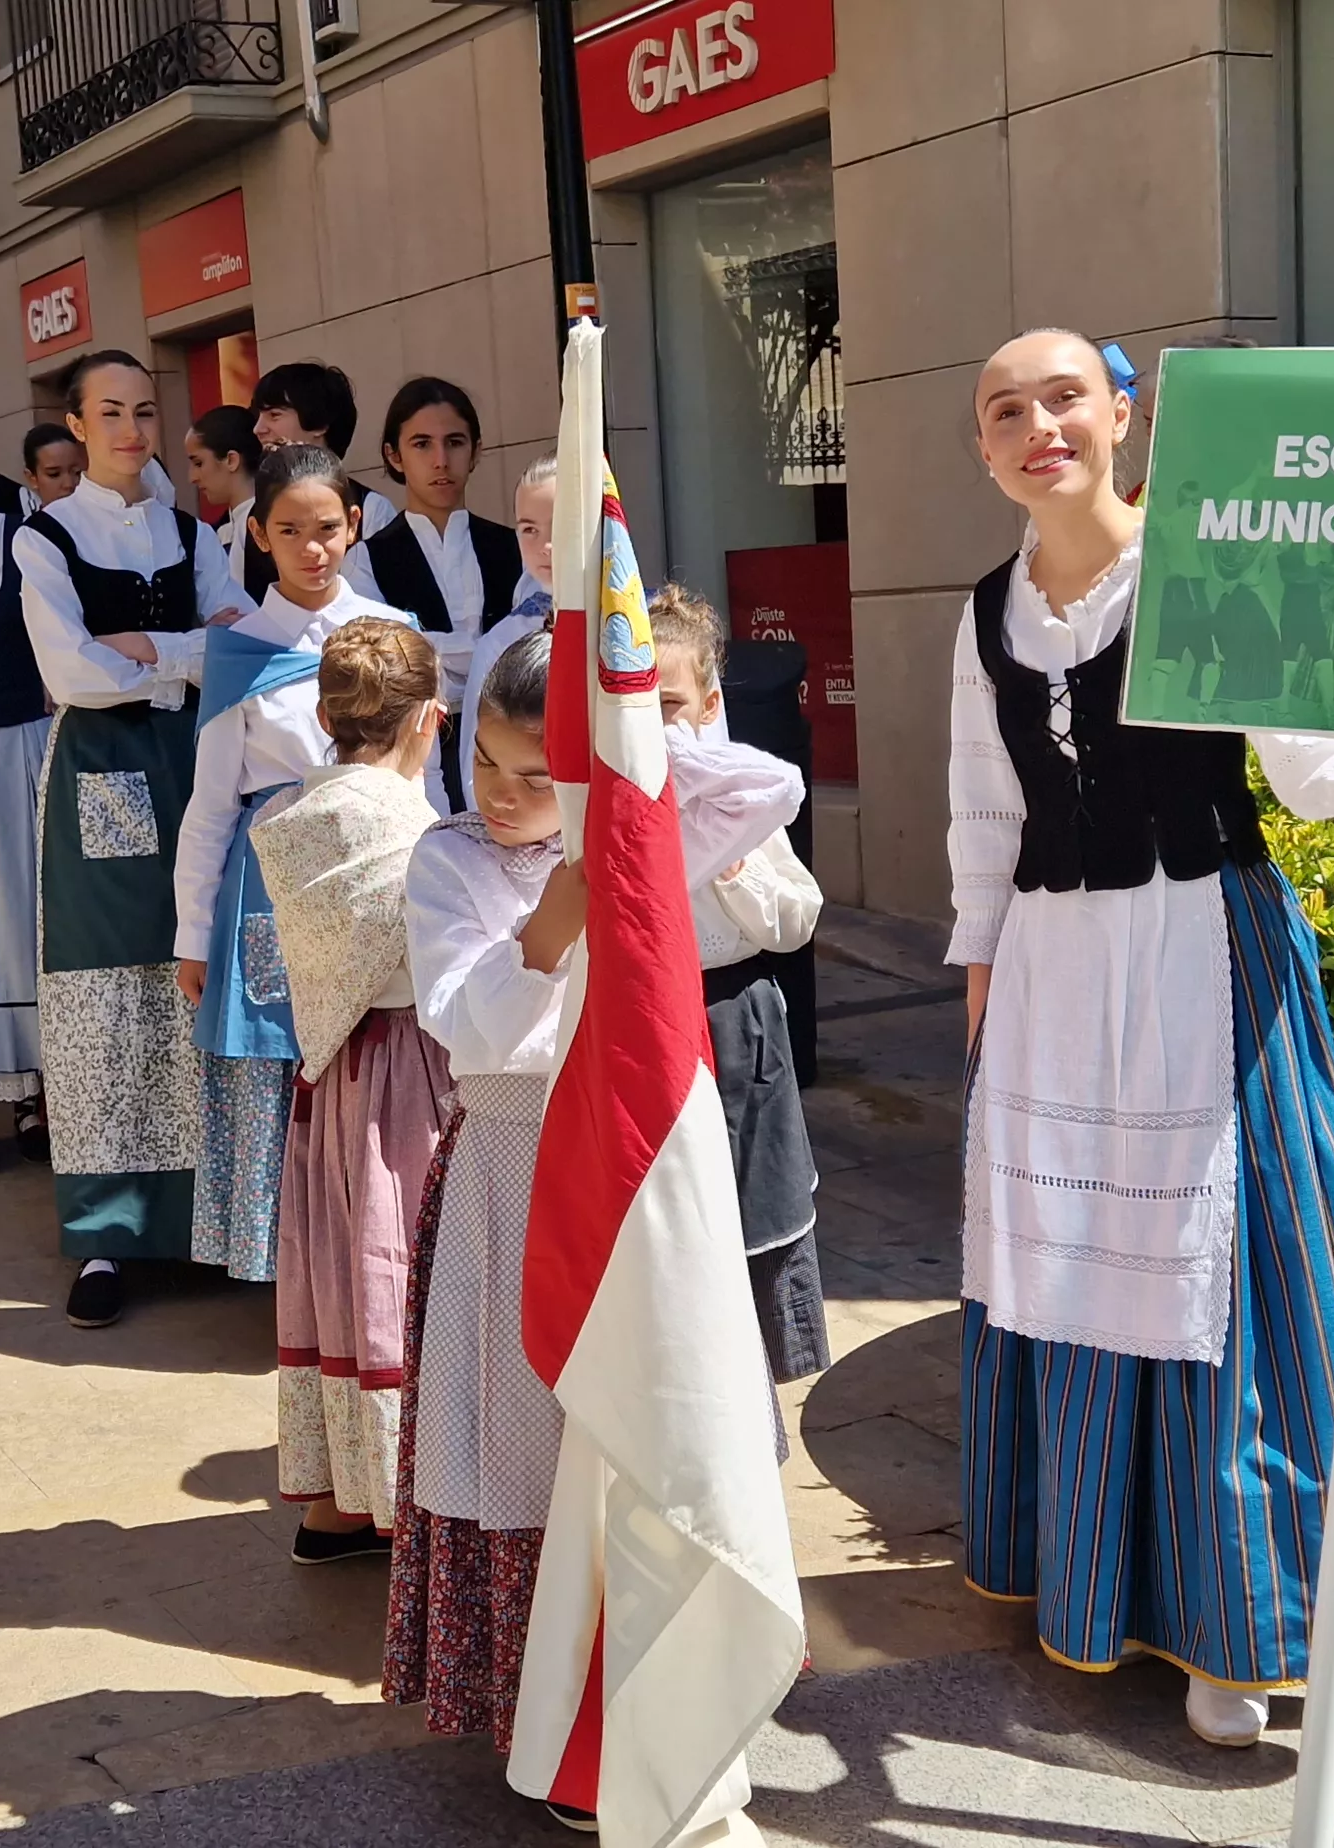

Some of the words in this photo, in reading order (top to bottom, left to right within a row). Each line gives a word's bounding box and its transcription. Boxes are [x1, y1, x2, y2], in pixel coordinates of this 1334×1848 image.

[628, 1, 758, 113] GAES
[202, 254, 243, 282] amplifon
[28, 286, 78, 343] GAES
[825, 678, 853, 690] ENTRA
